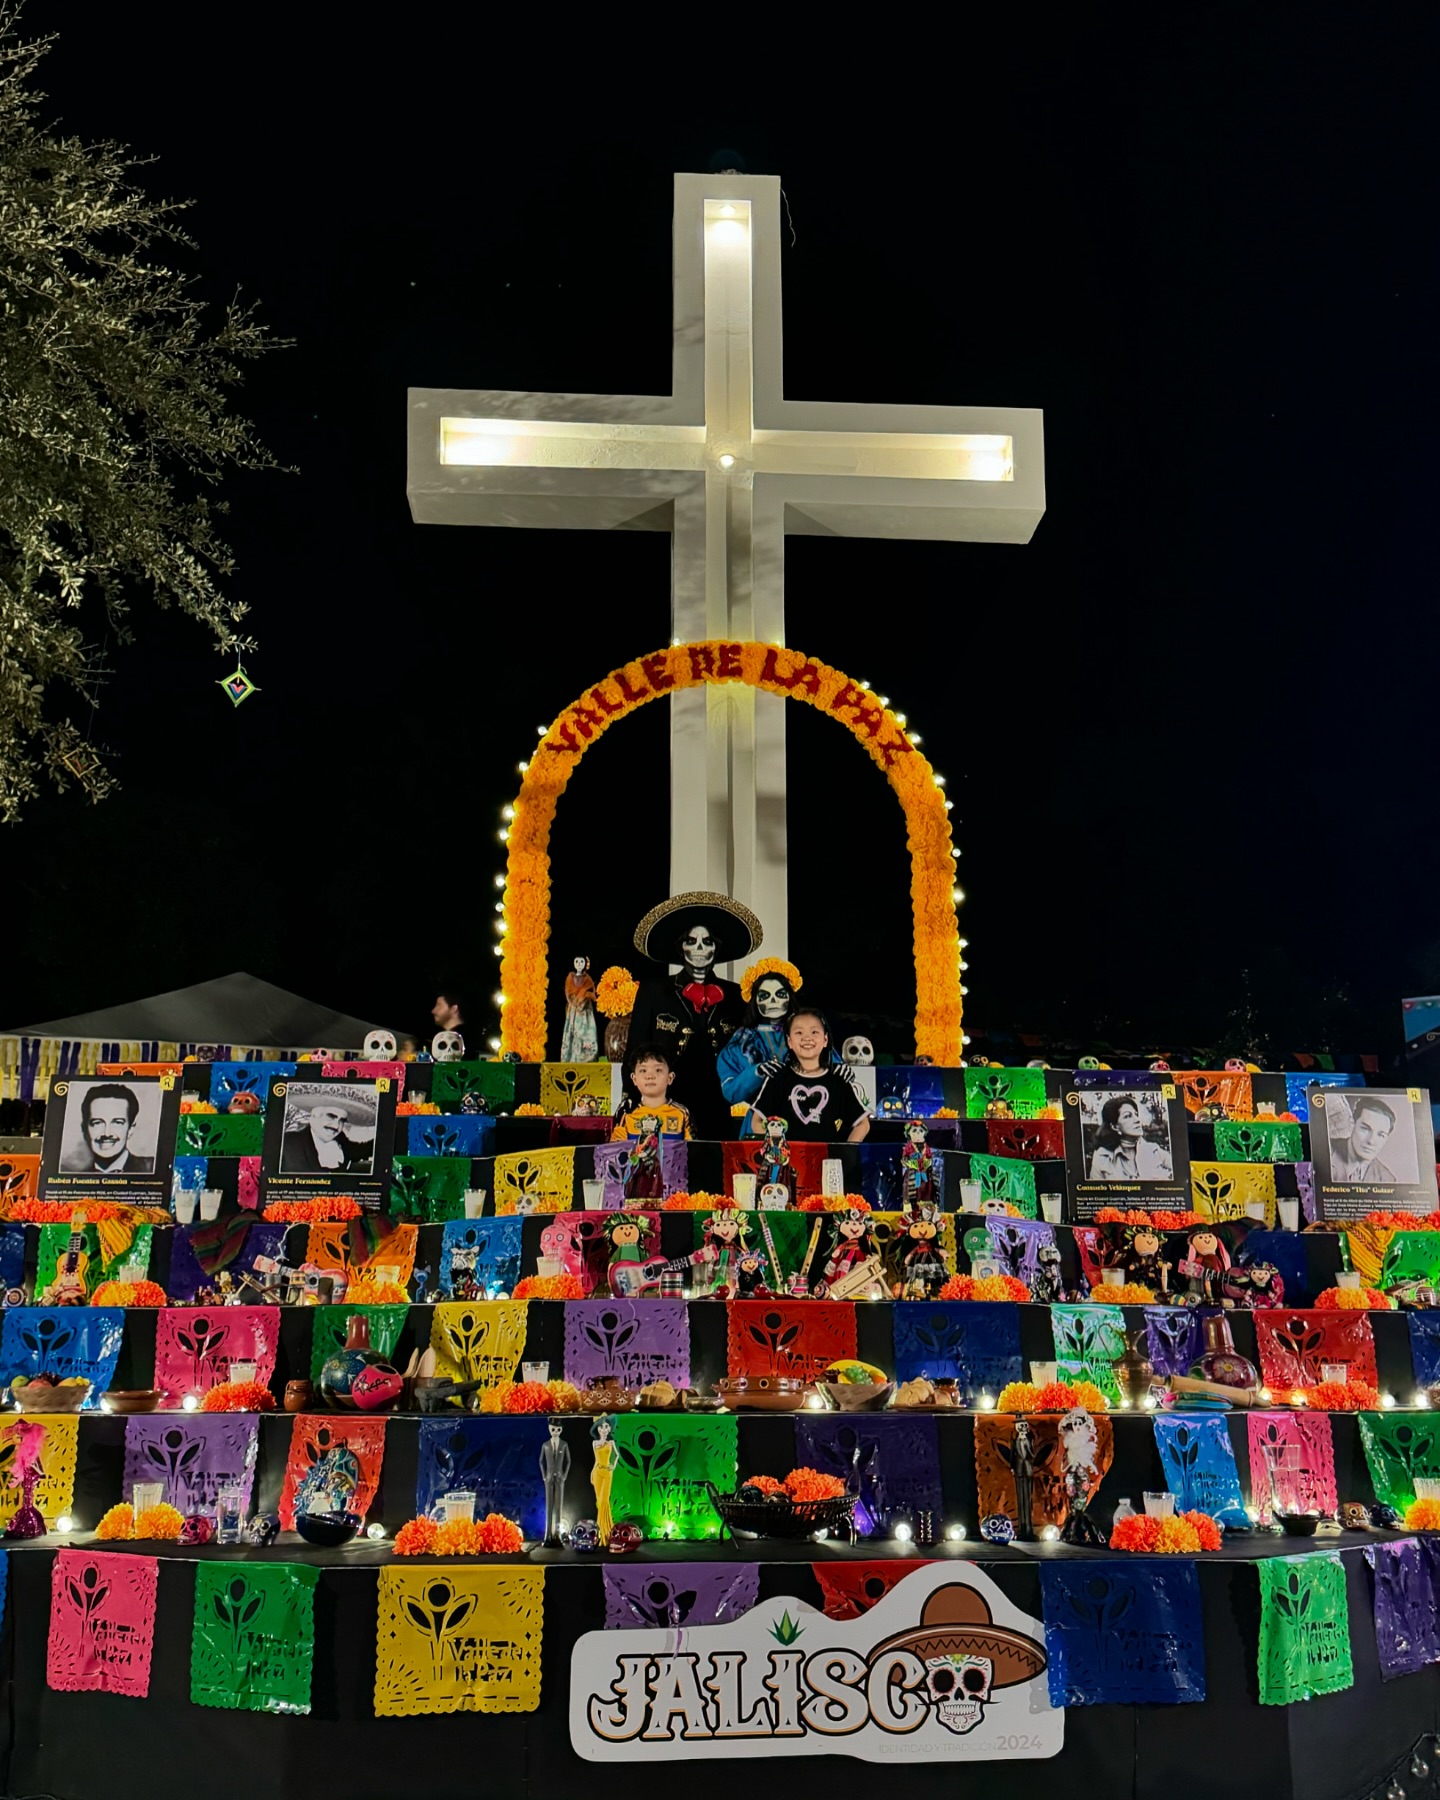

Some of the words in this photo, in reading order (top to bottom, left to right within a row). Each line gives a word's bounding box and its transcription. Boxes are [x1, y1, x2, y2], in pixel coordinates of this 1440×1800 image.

[545, 654, 675, 753] VALLE
[688, 644, 743, 680] DE
[760, 648, 821, 696] LA
[831, 682, 914, 766] PAZ
[997, 1734, 1043, 1751] 2024
